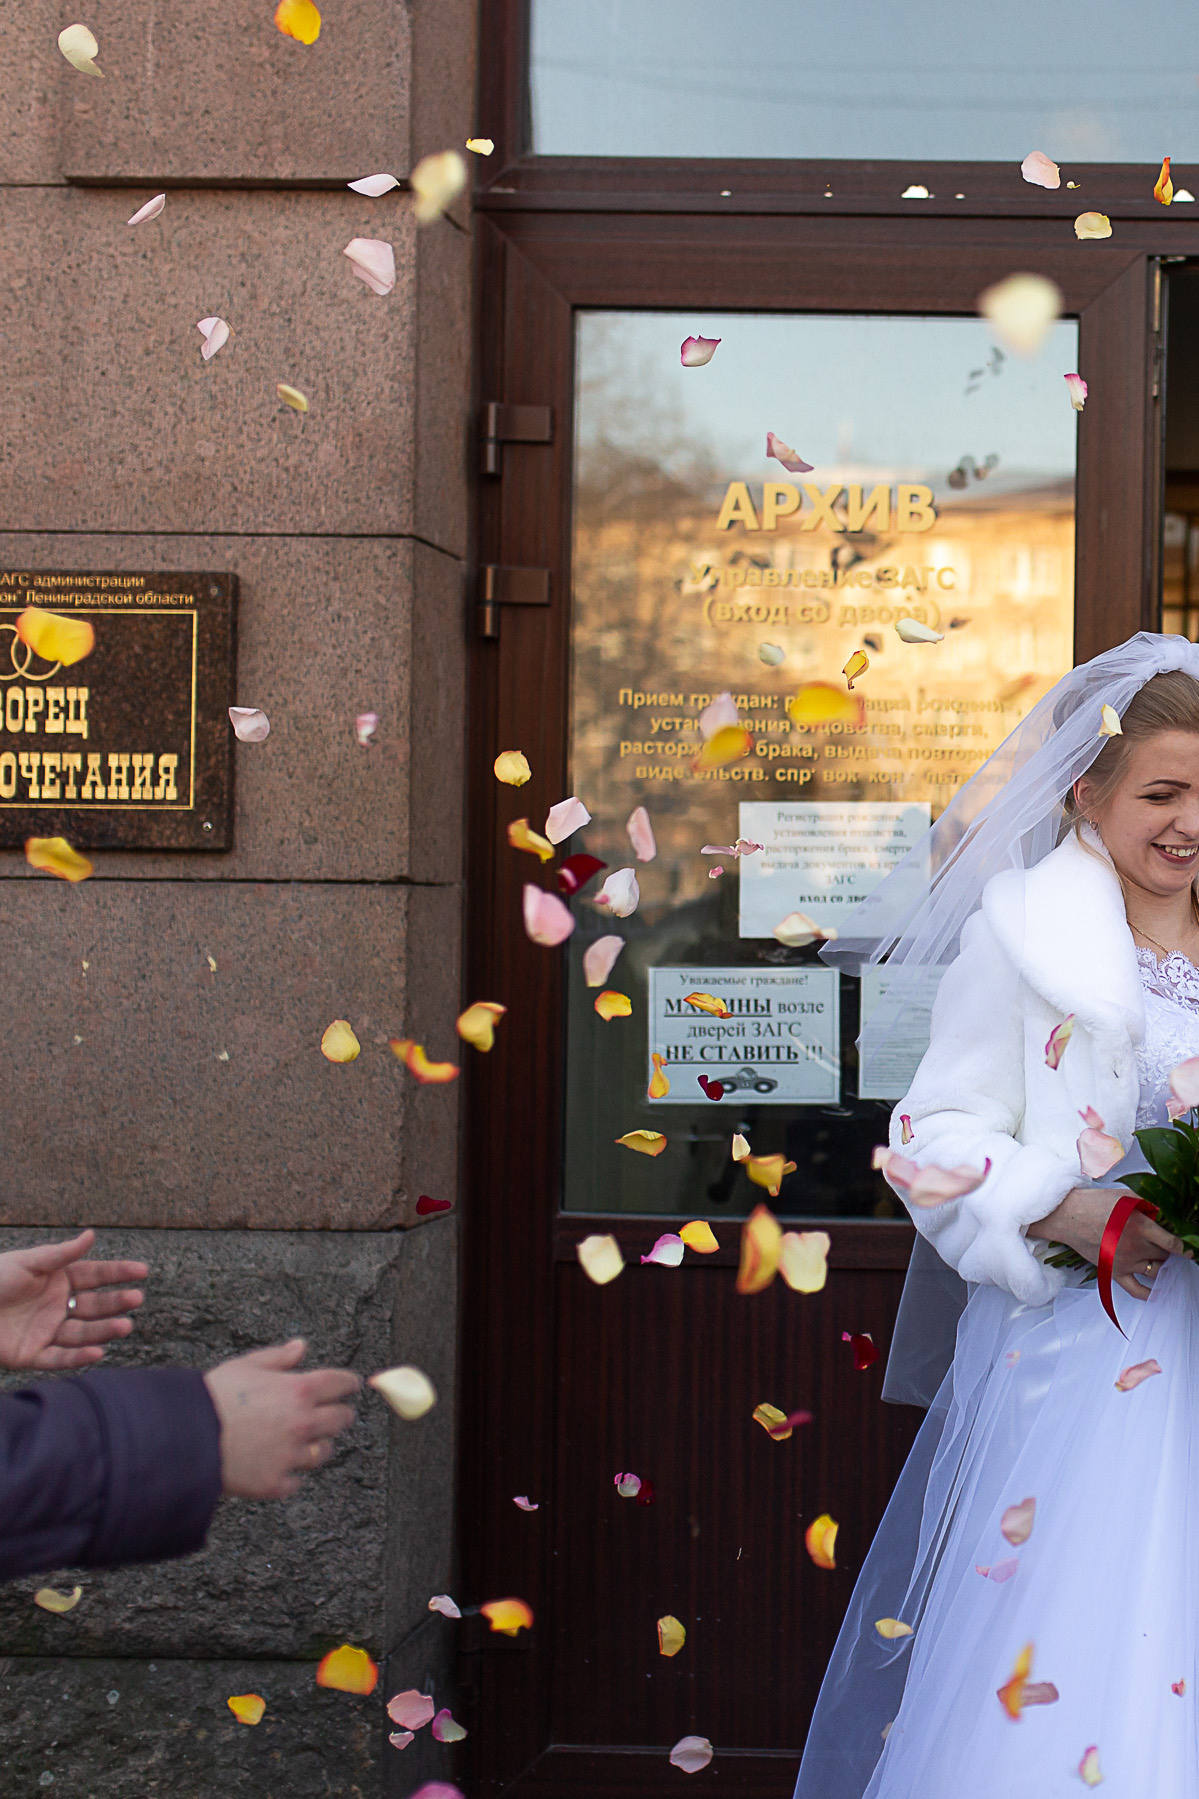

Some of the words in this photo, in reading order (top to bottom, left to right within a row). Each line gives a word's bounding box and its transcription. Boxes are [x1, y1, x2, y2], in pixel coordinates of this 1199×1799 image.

[715, 481, 938, 533] АРХИВ
[0, 573, 29, 587] АГС
[34, 574, 145, 588] администрации
[689, 564, 873, 590] Управление
[876, 566, 957, 591] ЗАГС
[0, 589, 22, 604] он"
[26, 590, 134, 606] Ленинградской
[136, 591, 194, 605] области
[703, 599, 789, 626] (вход
[799, 605, 831, 624] со
[618, 688, 684, 710] Прием
[690, 692, 778, 711] грдан:
[0, 685, 89, 740] ОРЕЦ
[650, 717, 791, 735] устанения
[619, 740, 750, 758] расторж
[755, 739, 820, 760] брака,
[824, 745, 901, 761] выдача
[0, 751, 179, 801] ОЧЕТАНИЯ
[829, 894, 844, 904] со
[679, 973, 747, 986] Уважаемые
[750, 974, 809, 988] граждане!
[778, 1001, 825, 1014] возле
[687, 1021, 746, 1041] дверей
[752, 1021, 802, 1038] ЗАГС
[666, 1045, 694, 1061] НЕ
[699, 1045, 799, 1061] СТАВИТЬ
